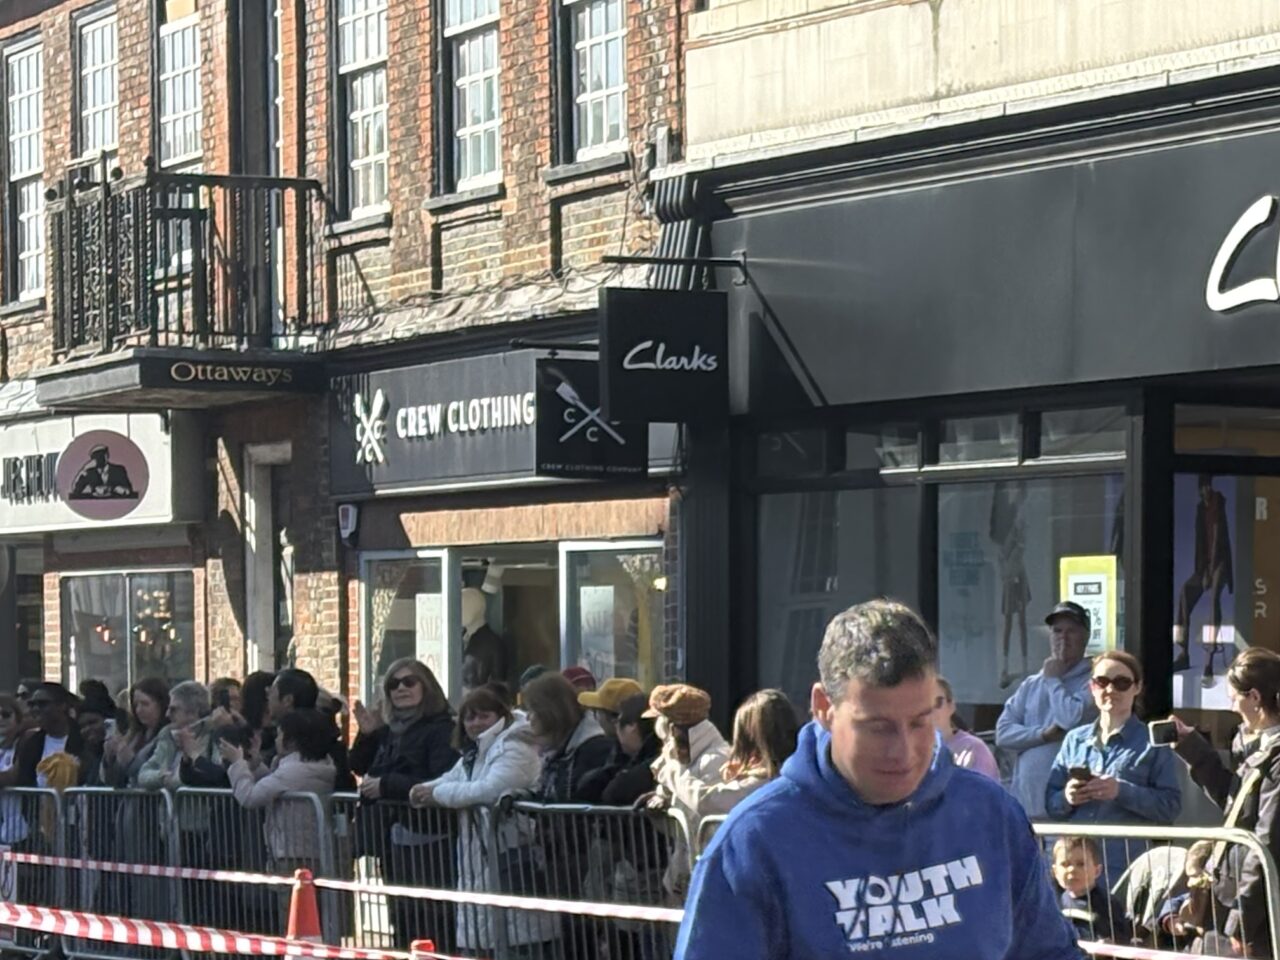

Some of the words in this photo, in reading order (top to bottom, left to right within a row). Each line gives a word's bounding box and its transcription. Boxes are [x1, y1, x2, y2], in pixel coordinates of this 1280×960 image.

[170, 361, 293, 386] Ottaways
[622, 340, 719, 371] Clarks
[396, 403, 442, 438] CREW
[447, 392, 536, 432] CLOTHING
[825, 856, 983, 910] YOUTH
[835, 894, 962, 940] TALK
